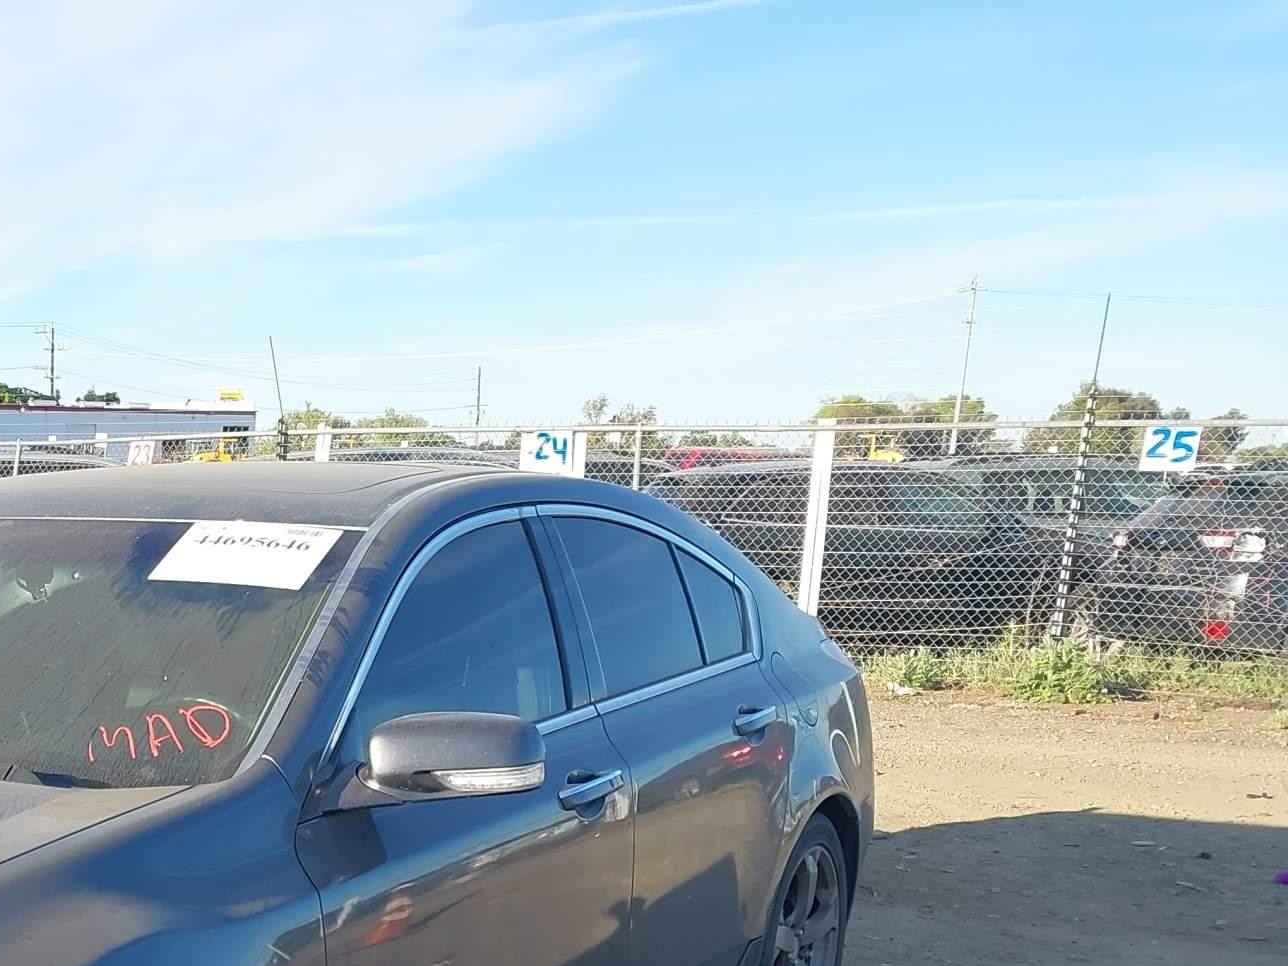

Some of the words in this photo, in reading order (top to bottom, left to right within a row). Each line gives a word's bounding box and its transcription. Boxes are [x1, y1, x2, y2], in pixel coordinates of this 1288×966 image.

[535, 432, 568, 465] 24
[1145, 427, 1198, 462] 25
[194, 534, 311, 552] 44695646
[88, 704, 232, 763] MAD
